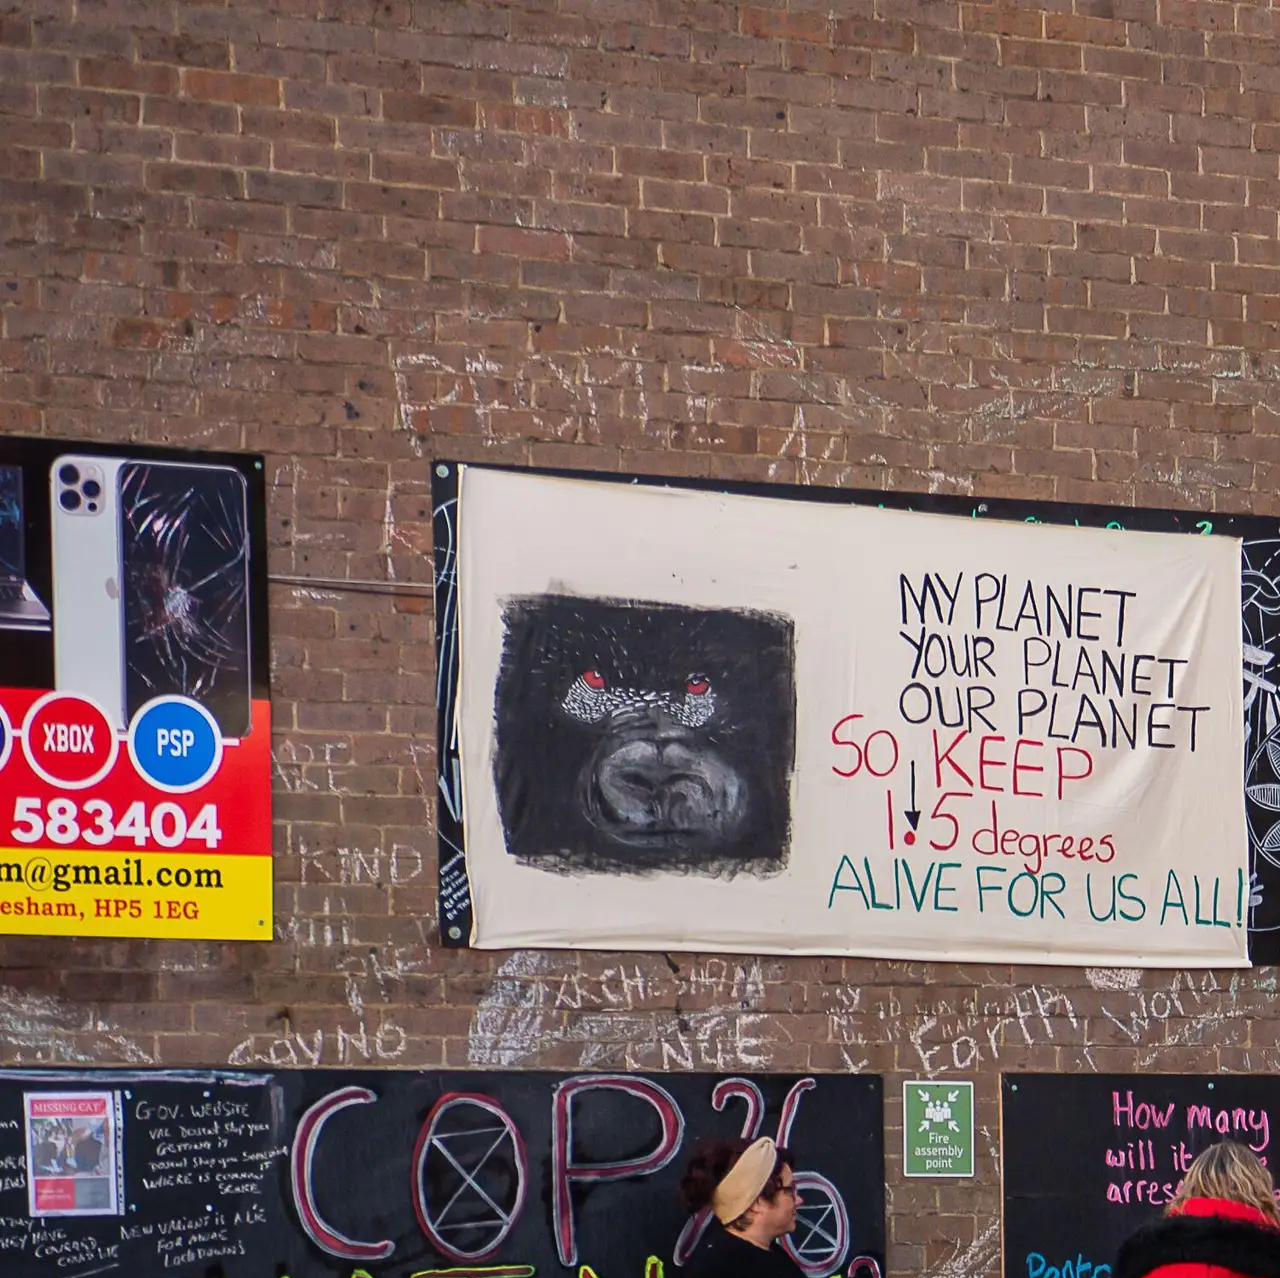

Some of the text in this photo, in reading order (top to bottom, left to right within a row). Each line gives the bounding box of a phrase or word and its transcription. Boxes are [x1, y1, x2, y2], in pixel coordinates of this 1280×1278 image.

[899, 571, 1137, 647] MY PLANET
[899, 627, 1189, 699] YOUR PLANET
[43, 723, 195, 758] XBOX PSP
[899, 682, 1211, 753] OUR PLANET
[831, 714, 1093, 801] SO KEEP
[10, 796, 223, 849] 583404
[971, 800, 1116, 874] degrees
[0, 856, 224, 892] m@gmail.com
[299, 837, 423, 888] KIND
[94, 898, 143, 919] HP5
[152, 900, 200, 920] 1EG
[828, 855, 1246, 929] ALIVE FOR US ALL!
[33, 1102, 102, 1114] MISSING CAT
[1112, 1090, 1176, 1131] How
[1186, 1103, 1271, 1153] many
[914, 1145, 964, 1159] assembly
[925, 1157, 953, 1170] point
[928, 1132, 950, 1144] Fire
[1105, 1138, 1155, 1172] will
[1170, 1141, 1194, 1173] it
